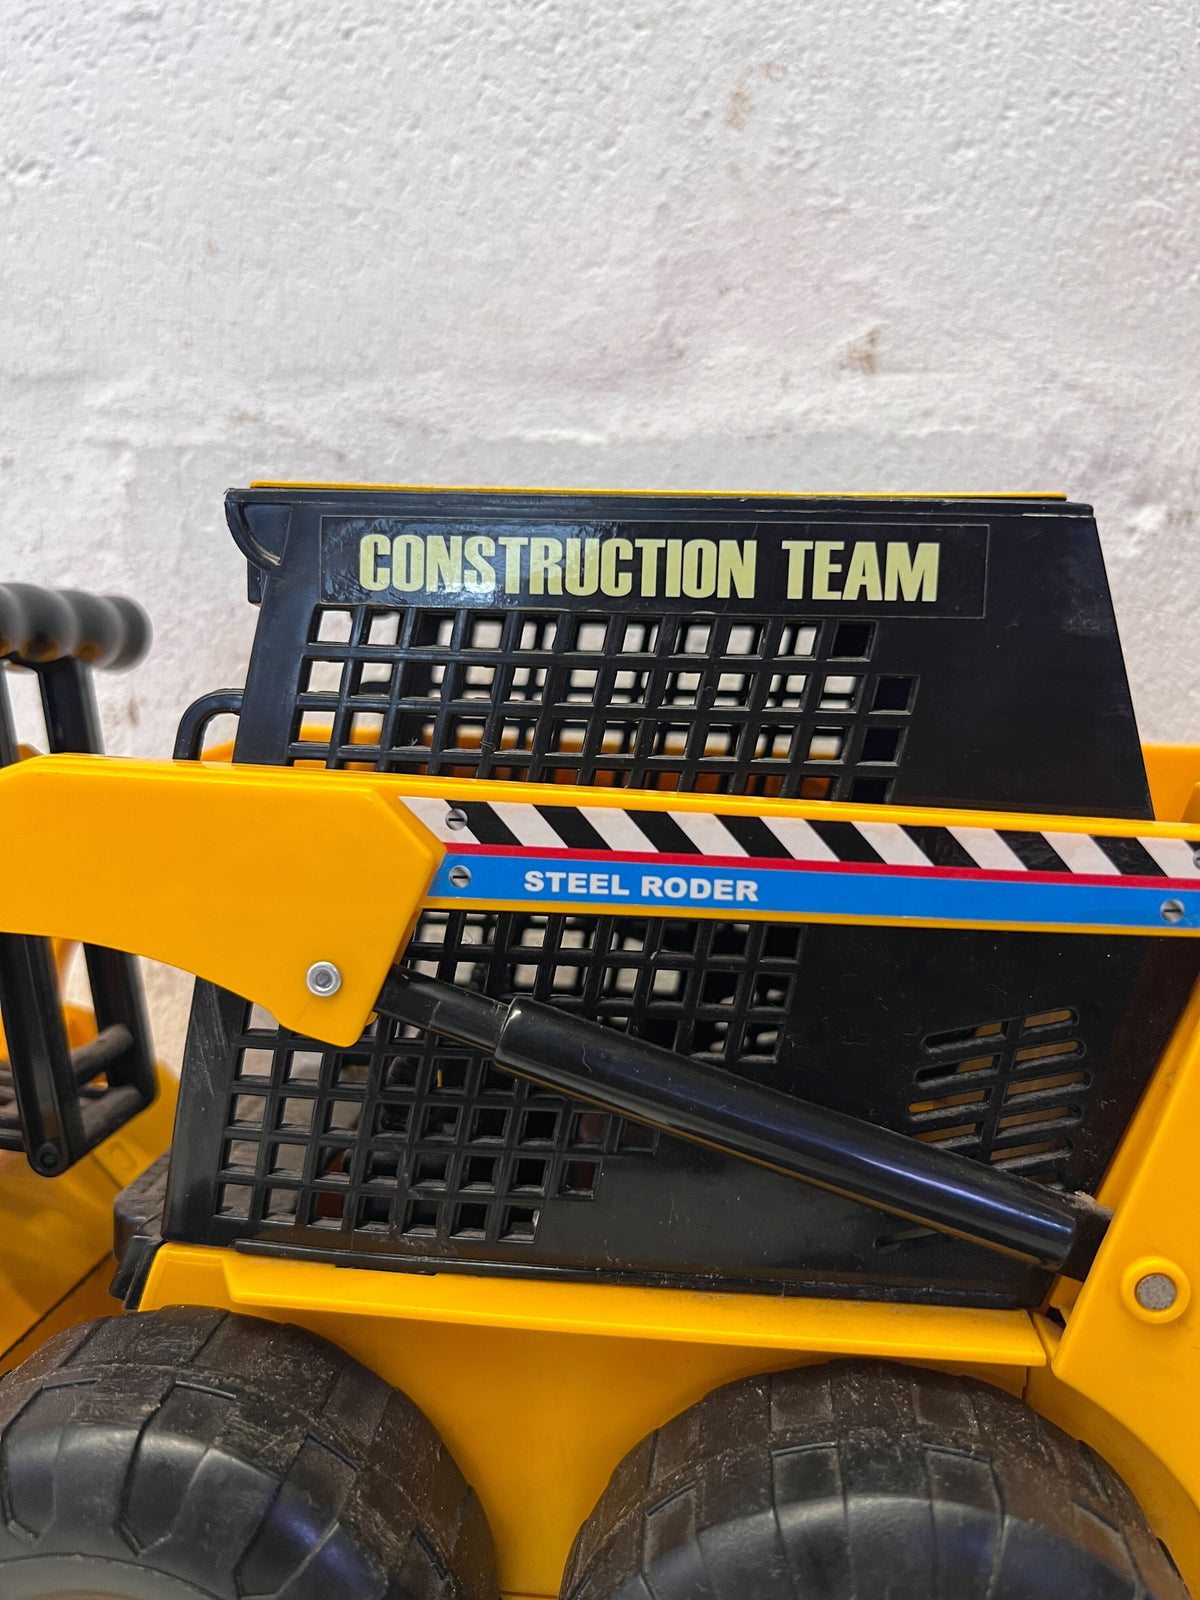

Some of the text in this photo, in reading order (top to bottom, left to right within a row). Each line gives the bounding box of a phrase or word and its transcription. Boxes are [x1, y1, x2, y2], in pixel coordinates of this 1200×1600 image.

[358, 533, 940, 602] CONSTRUCTION TEAM
[523, 870, 759, 902] STEEL RODER
